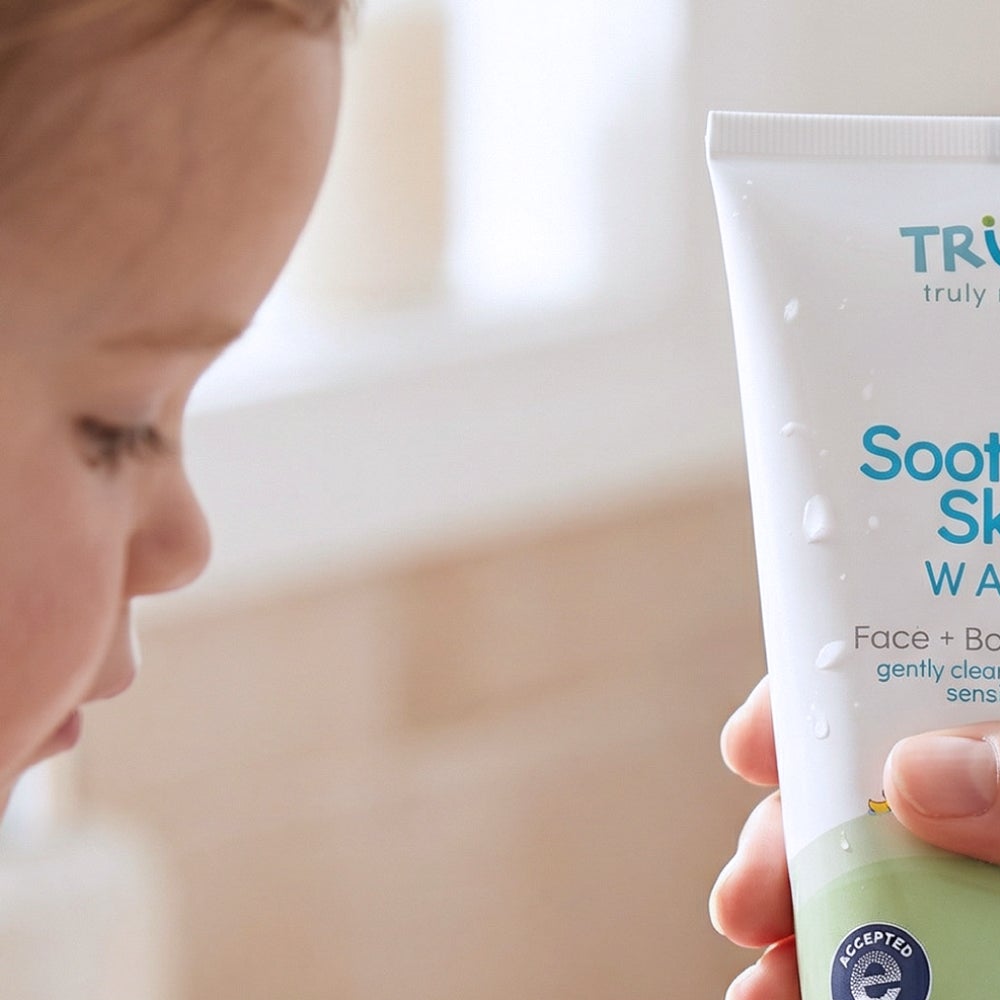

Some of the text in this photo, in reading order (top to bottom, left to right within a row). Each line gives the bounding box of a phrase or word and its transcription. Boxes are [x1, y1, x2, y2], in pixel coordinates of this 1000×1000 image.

[923, 282, 986, 308] truly
[854, 625, 930, 650] Face
[876, 658, 945, 683] gently
[839, 931, 913, 969] ACCEPTED
